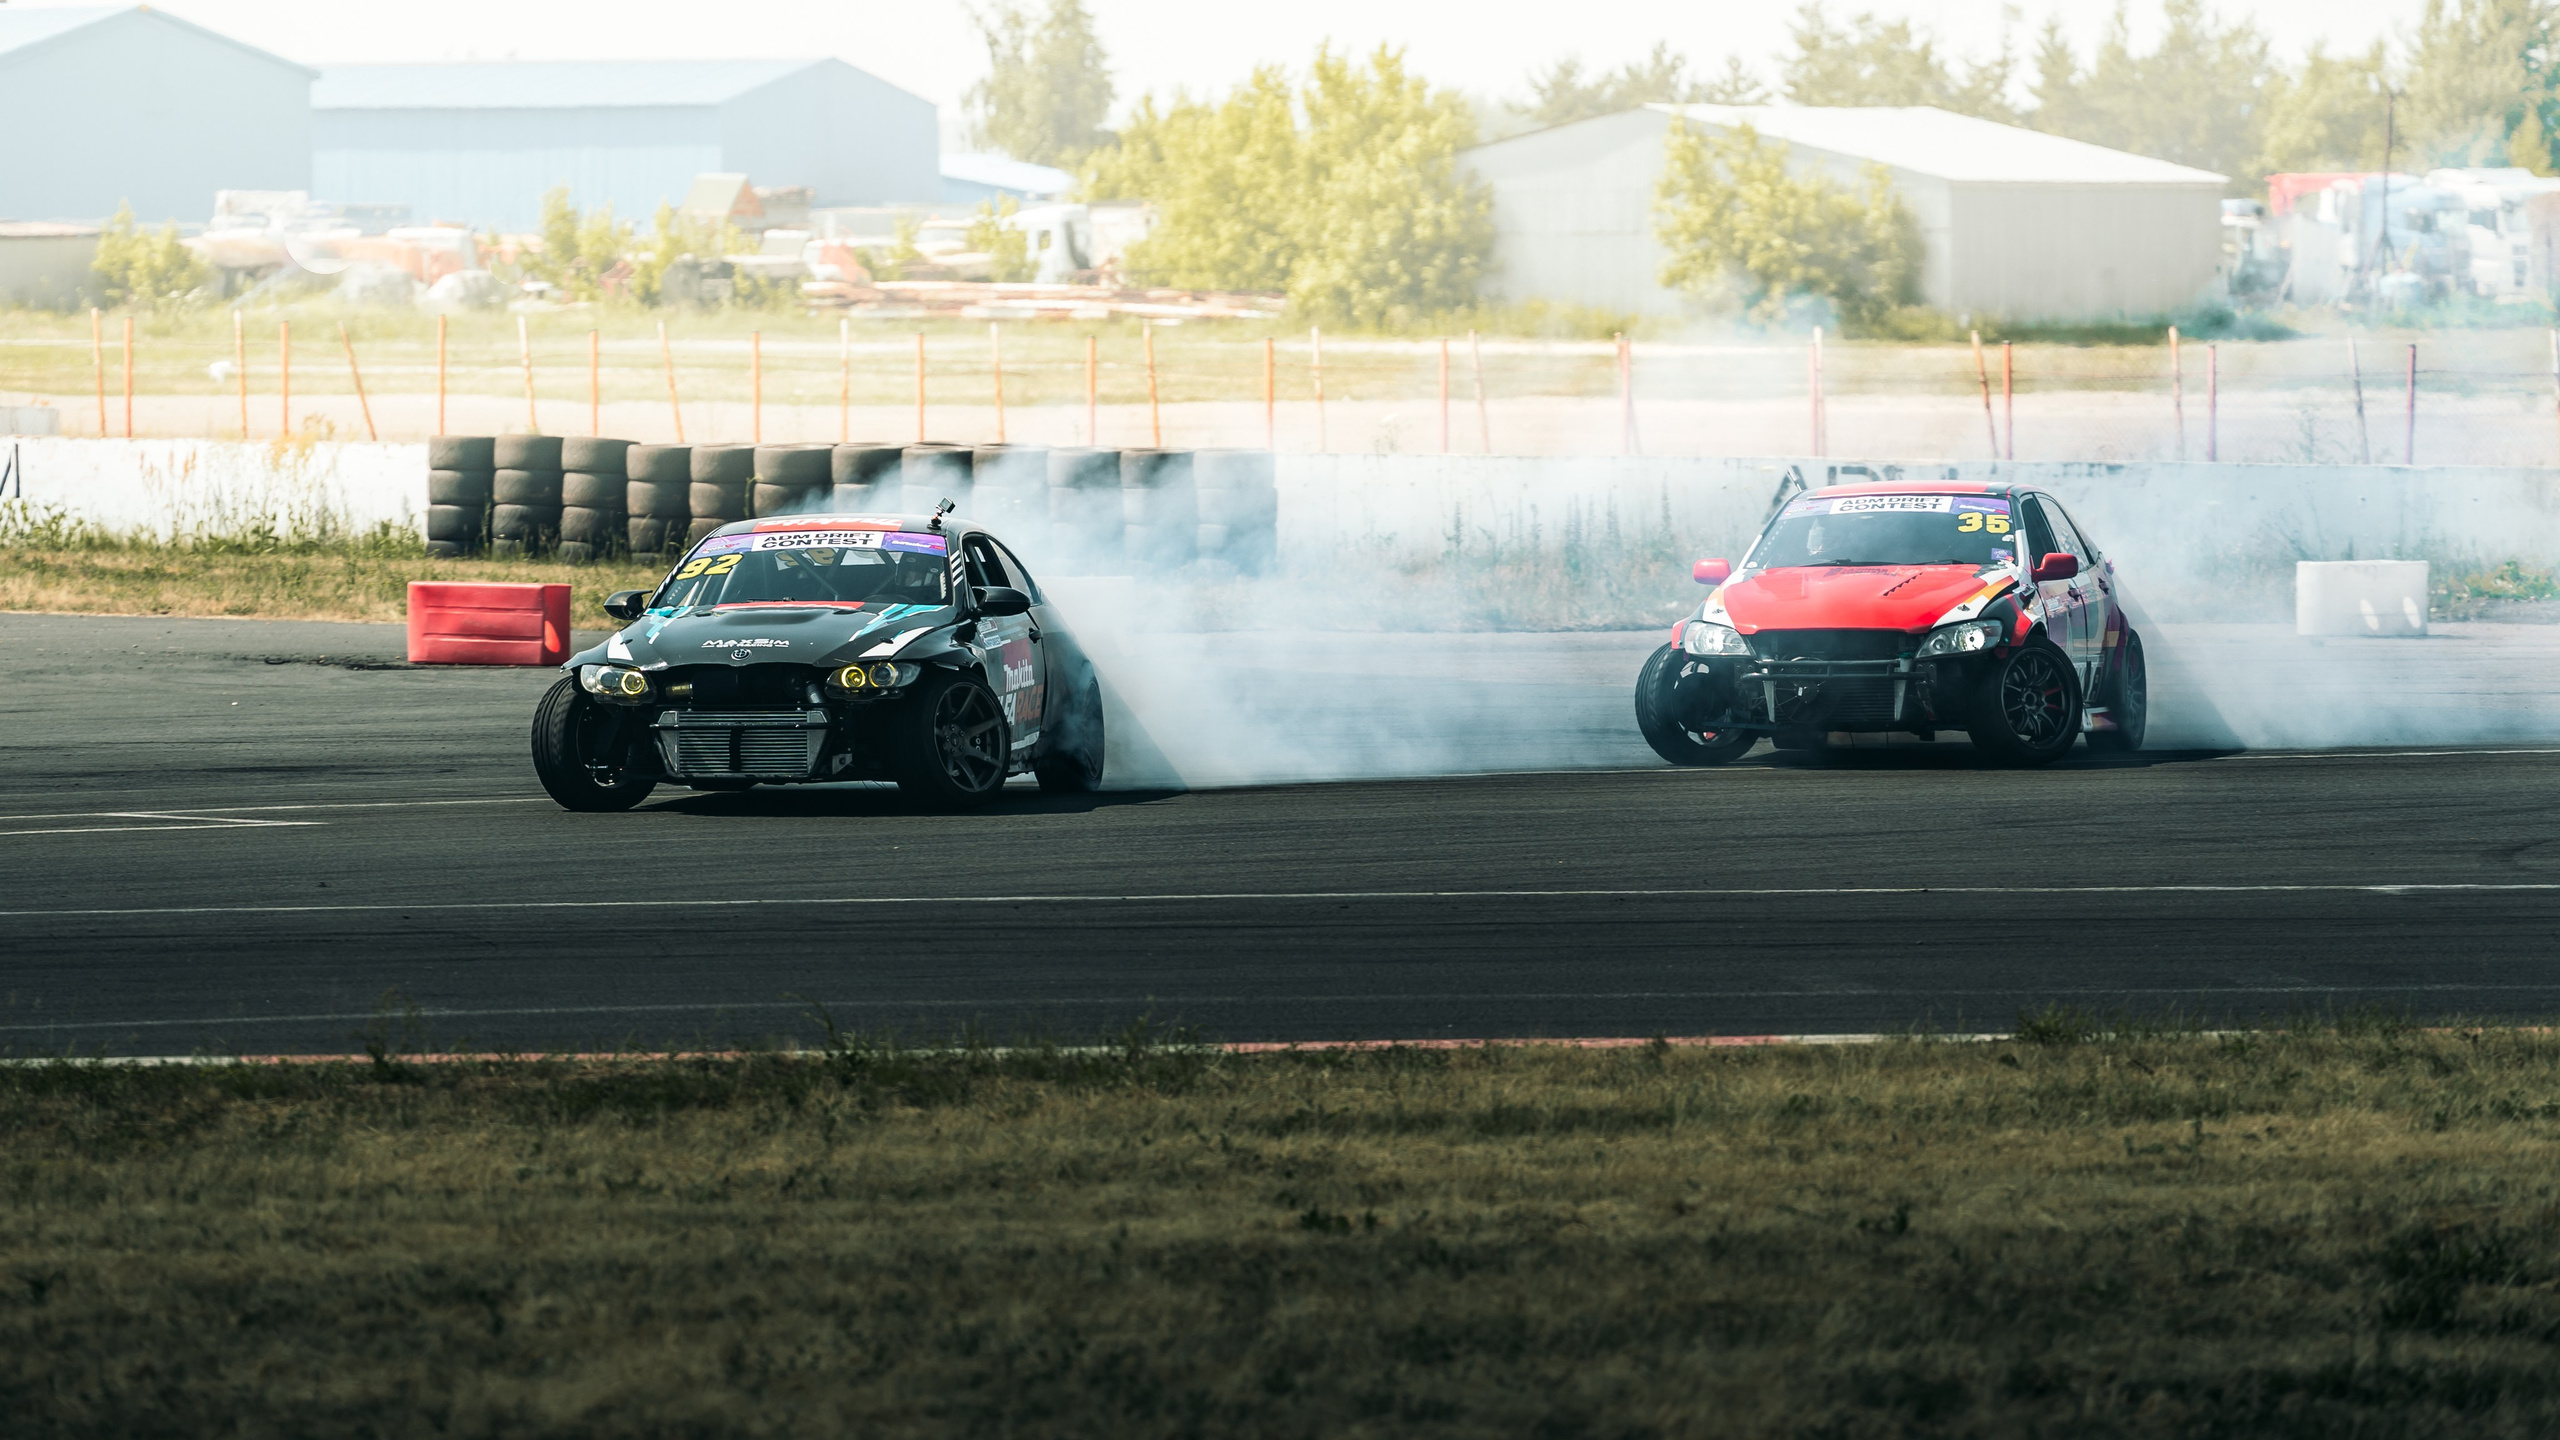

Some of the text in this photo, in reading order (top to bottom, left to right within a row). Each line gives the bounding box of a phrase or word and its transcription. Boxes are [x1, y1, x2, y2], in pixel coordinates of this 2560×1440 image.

[1839, 502, 1942, 511] CONTEST
[1957, 512, 2010, 534] 35
[763, 533, 815, 542] ADM
[761, 538, 874, 548] CONTEST
[676, 553, 743, 580] 92
